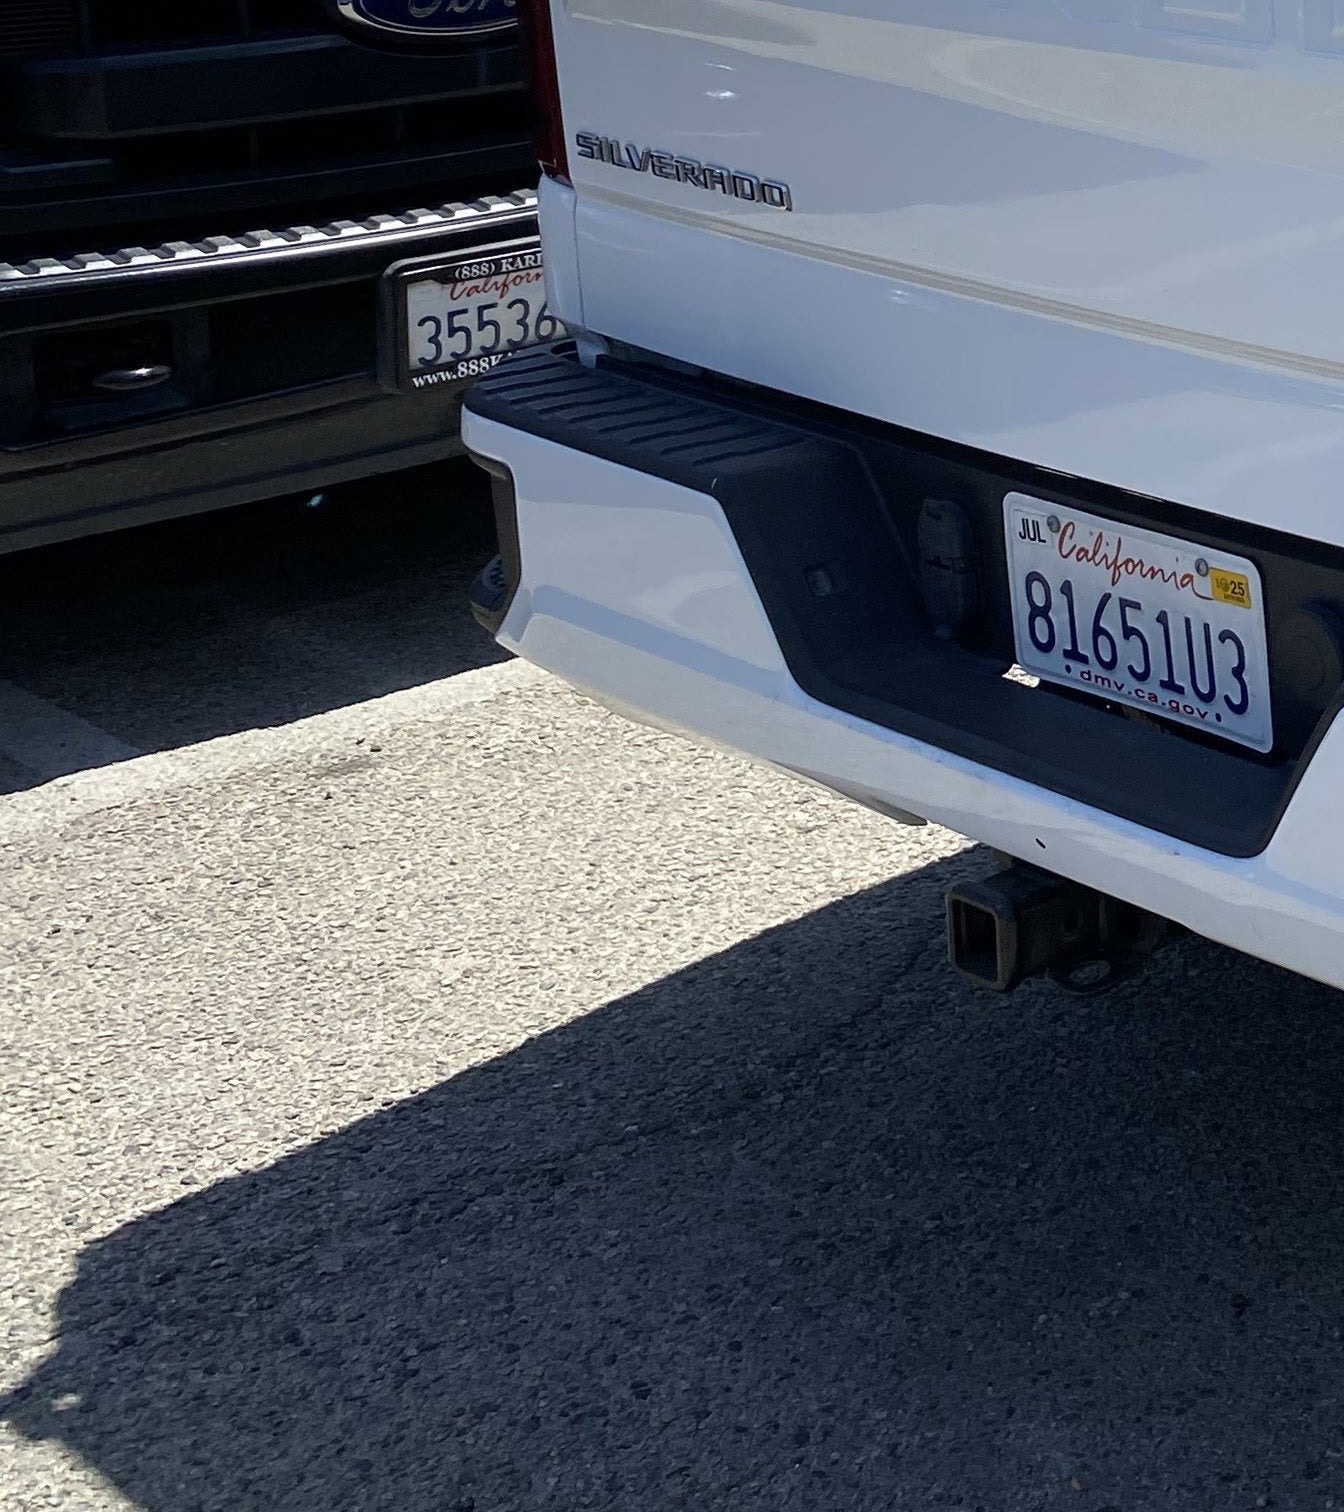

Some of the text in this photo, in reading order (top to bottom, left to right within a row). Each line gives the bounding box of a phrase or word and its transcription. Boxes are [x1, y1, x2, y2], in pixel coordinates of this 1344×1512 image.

[575, 130, 793, 212] SILVERADO
[455, 262, 495, 280] (888)
[1018, 517, 1047, 544] JUL
[1057, 520, 1214, 601] California
[1229, 578, 1246, 597] 25
[1025, 570, 1250, 716] 81651U3
